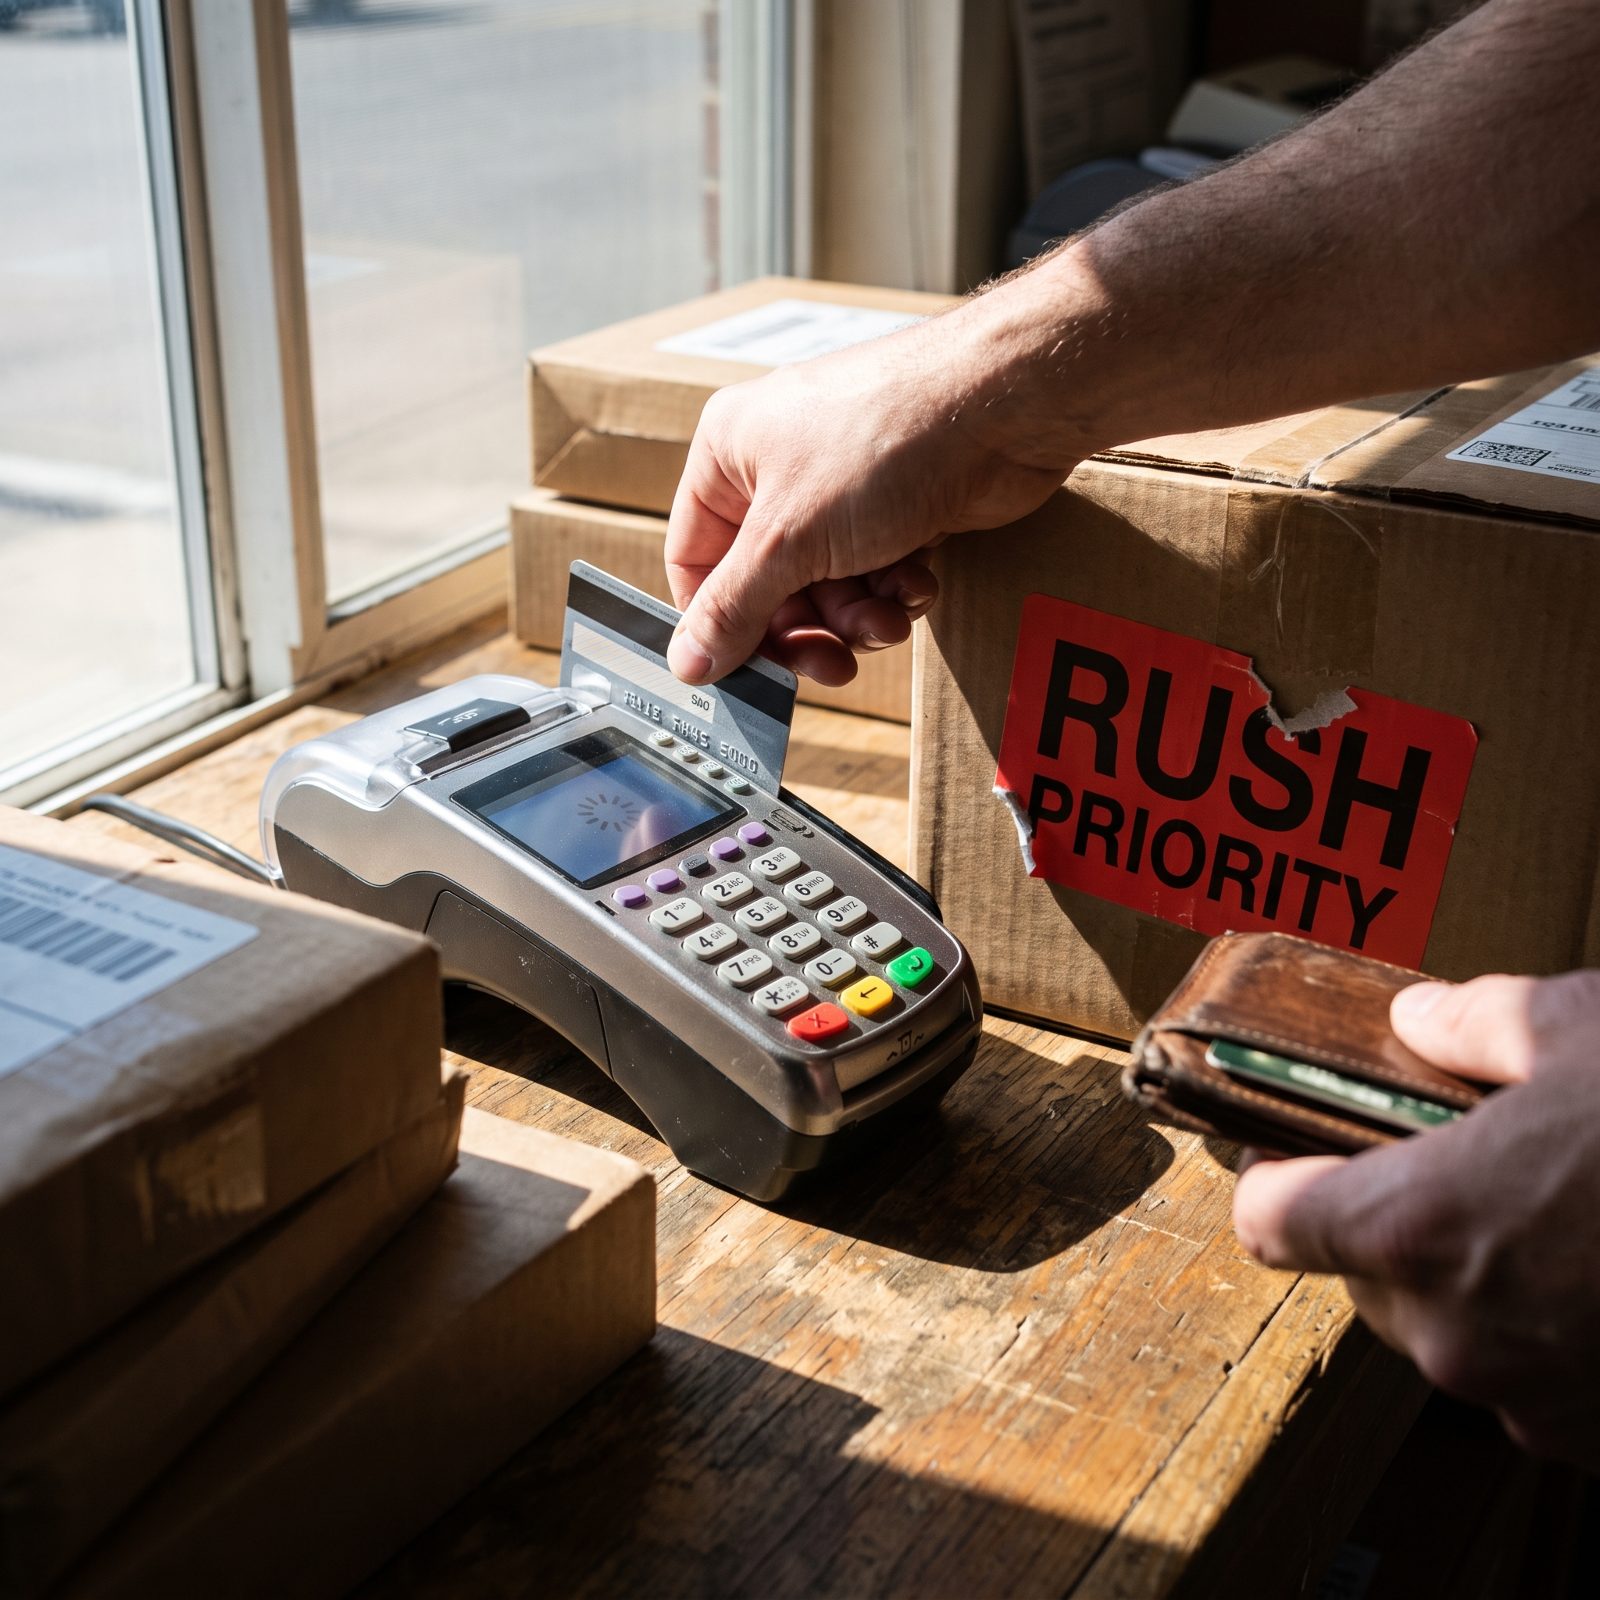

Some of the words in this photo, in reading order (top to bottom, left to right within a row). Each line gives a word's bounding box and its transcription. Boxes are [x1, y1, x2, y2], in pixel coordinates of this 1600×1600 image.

[1037, 638, 1432, 871] RUSH
[761, 859, 778, 871] 3
[1029, 773, 1398, 950] PRIORITY
[713, 884, 732, 897] 2
[726, 877, 744, 889] ABC
[794, 883, 811, 896] 6
[663, 910, 679, 921] 1
[746, 908, 764, 922] 5
[827, 909, 844, 922] 9
[698, 936, 714, 948] 4
[781, 935, 798, 948] 8
[728, 962, 744, 977] 7
[816, 962, 833, 976] 0
